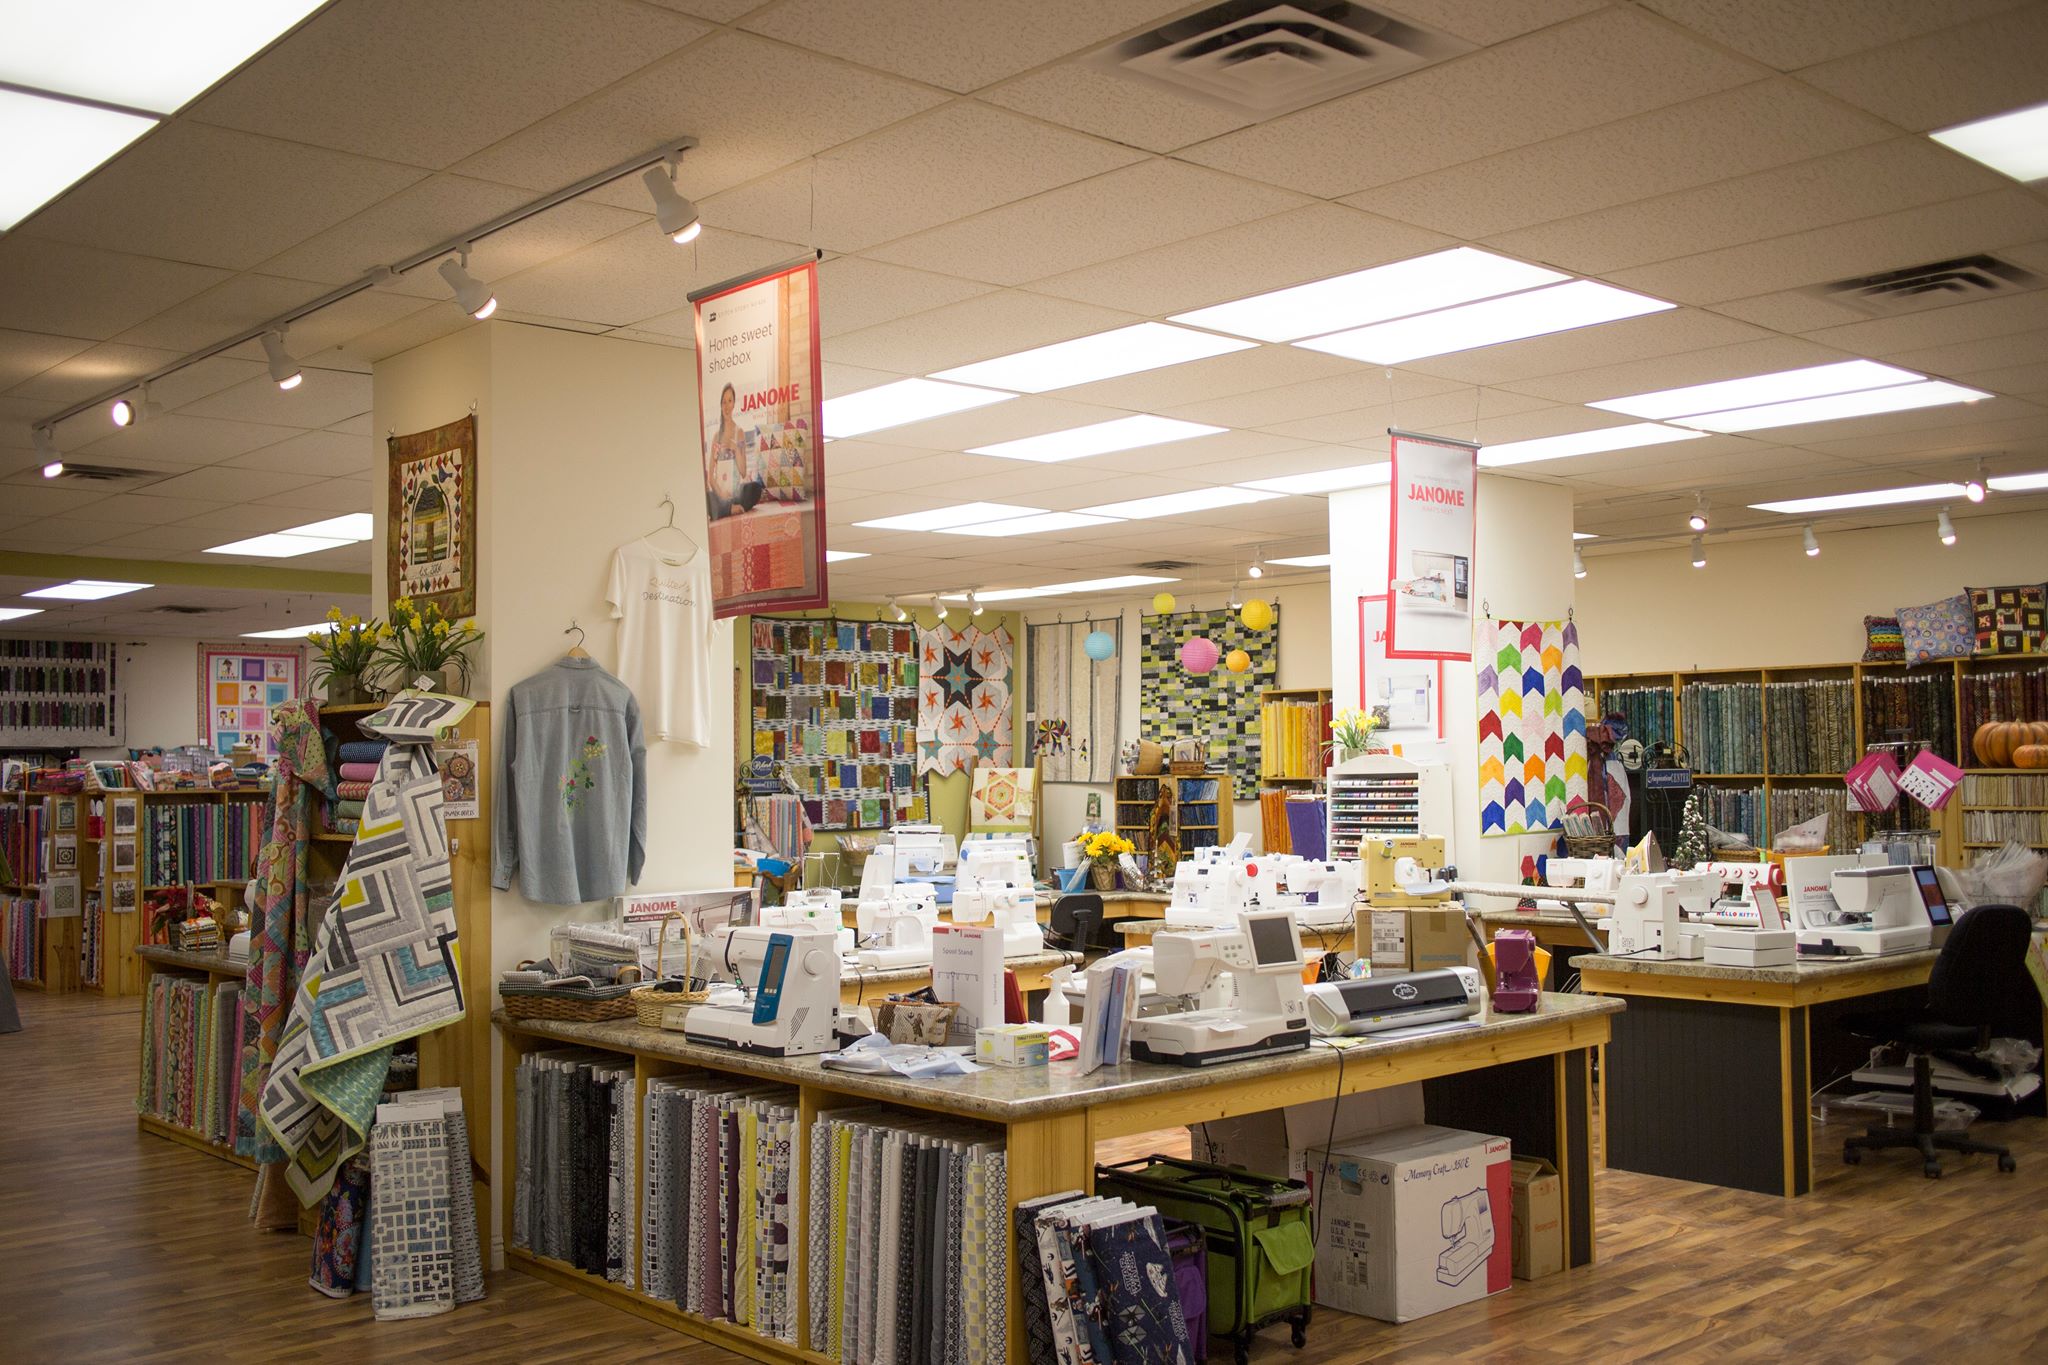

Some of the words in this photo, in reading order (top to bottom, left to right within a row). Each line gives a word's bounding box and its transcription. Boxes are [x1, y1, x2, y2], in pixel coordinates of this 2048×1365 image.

[709, 334, 738, 353] Home
[741, 323, 773, 344] sweet
[709, 351, 751, 374] shoebox
[740, 384, 800, 412] JANOME
[1408, 482, 1465, 507] JANOME
[1804, 885, 1828, 893] JANOME
[628, 901, 677, 914] JANOME
[1489, 1141, 1509, 1154] JANOME
[1404, 1169, 1431, 1182] Memory
[1433, 1163, 1451, 1177] Craft
